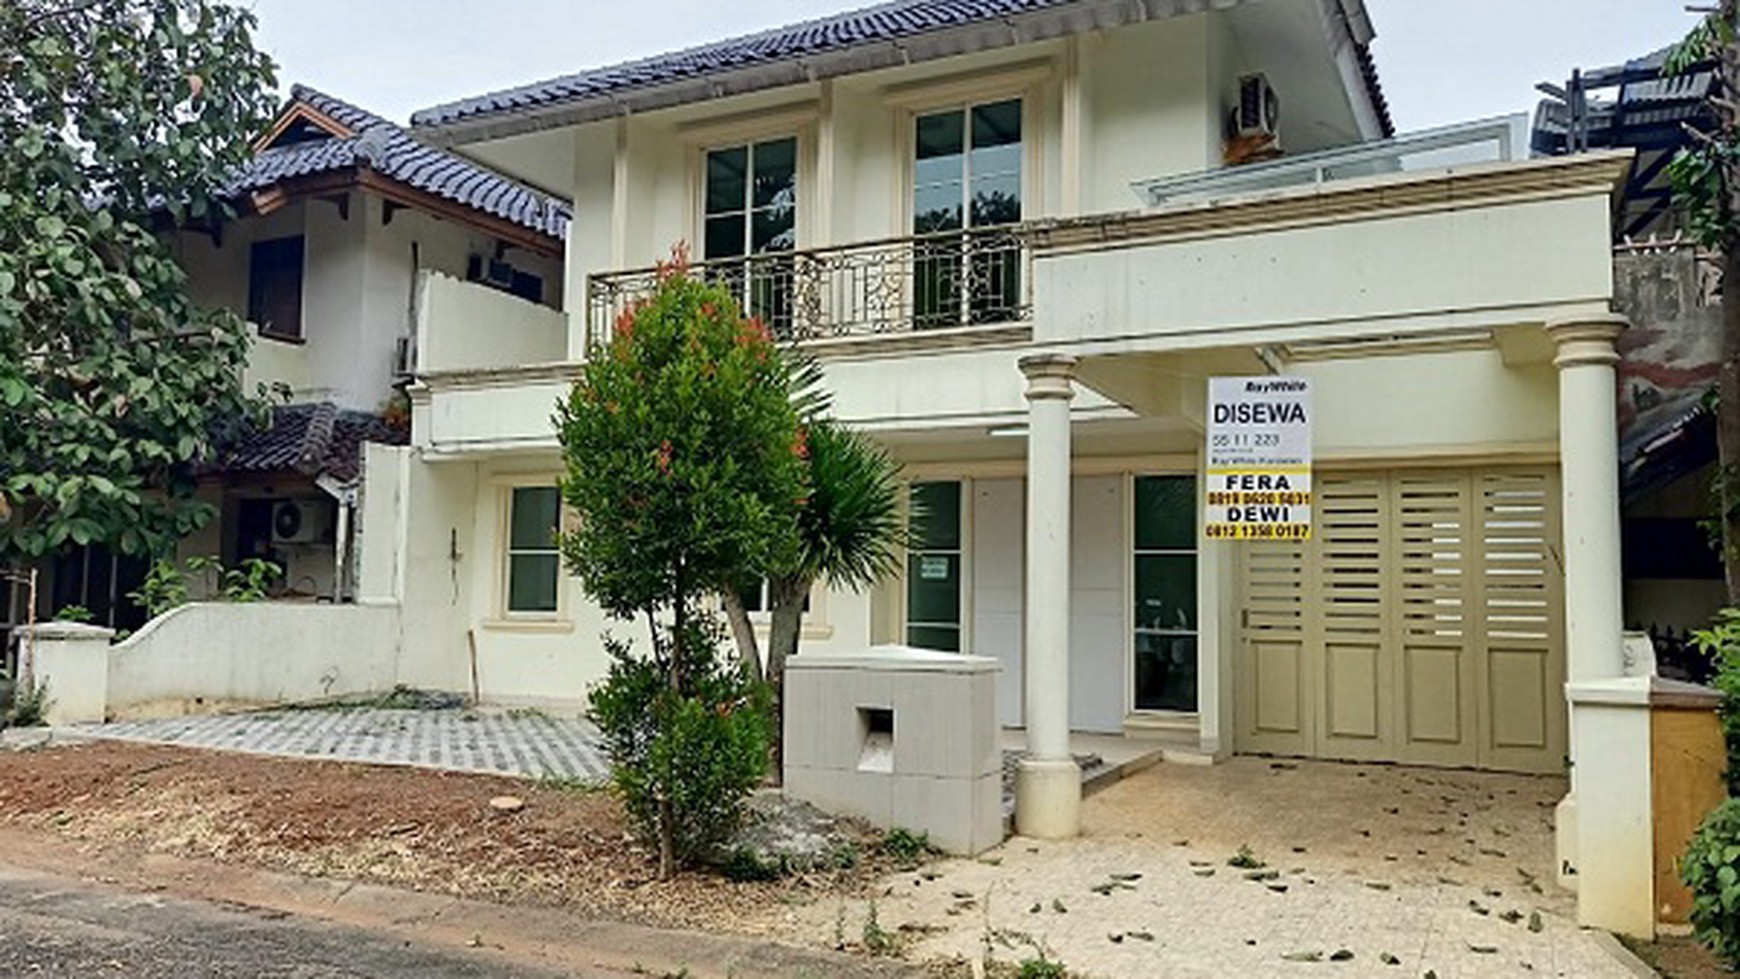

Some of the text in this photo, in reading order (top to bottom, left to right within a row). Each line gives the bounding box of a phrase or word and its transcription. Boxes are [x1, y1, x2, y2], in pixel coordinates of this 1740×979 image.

[1214, 402, 1306, 423] DISEWA
[1226, 475, 1290, 490] FERA
[1227, 507, 1289, 522] DEWI
